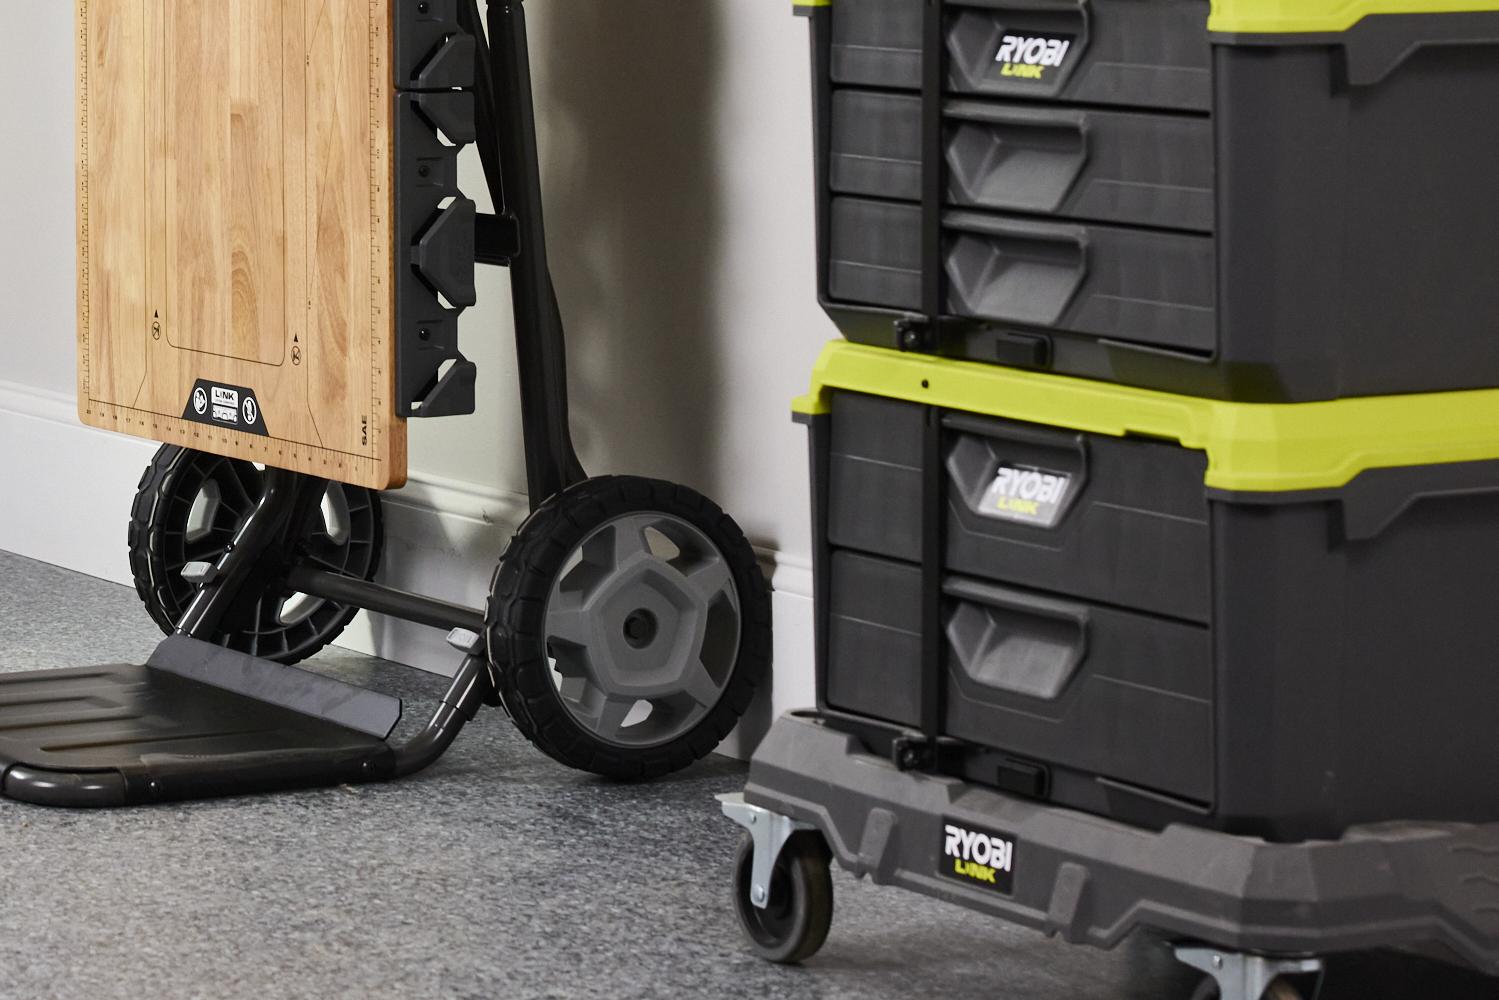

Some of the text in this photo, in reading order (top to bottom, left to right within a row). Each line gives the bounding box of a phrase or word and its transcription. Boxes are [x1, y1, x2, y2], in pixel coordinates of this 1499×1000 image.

[995, 35, 1070, 67] RYOBI
[991, 466, 1067, 504] RYOBI
[944, 824, 1013, 872] RYOBI
